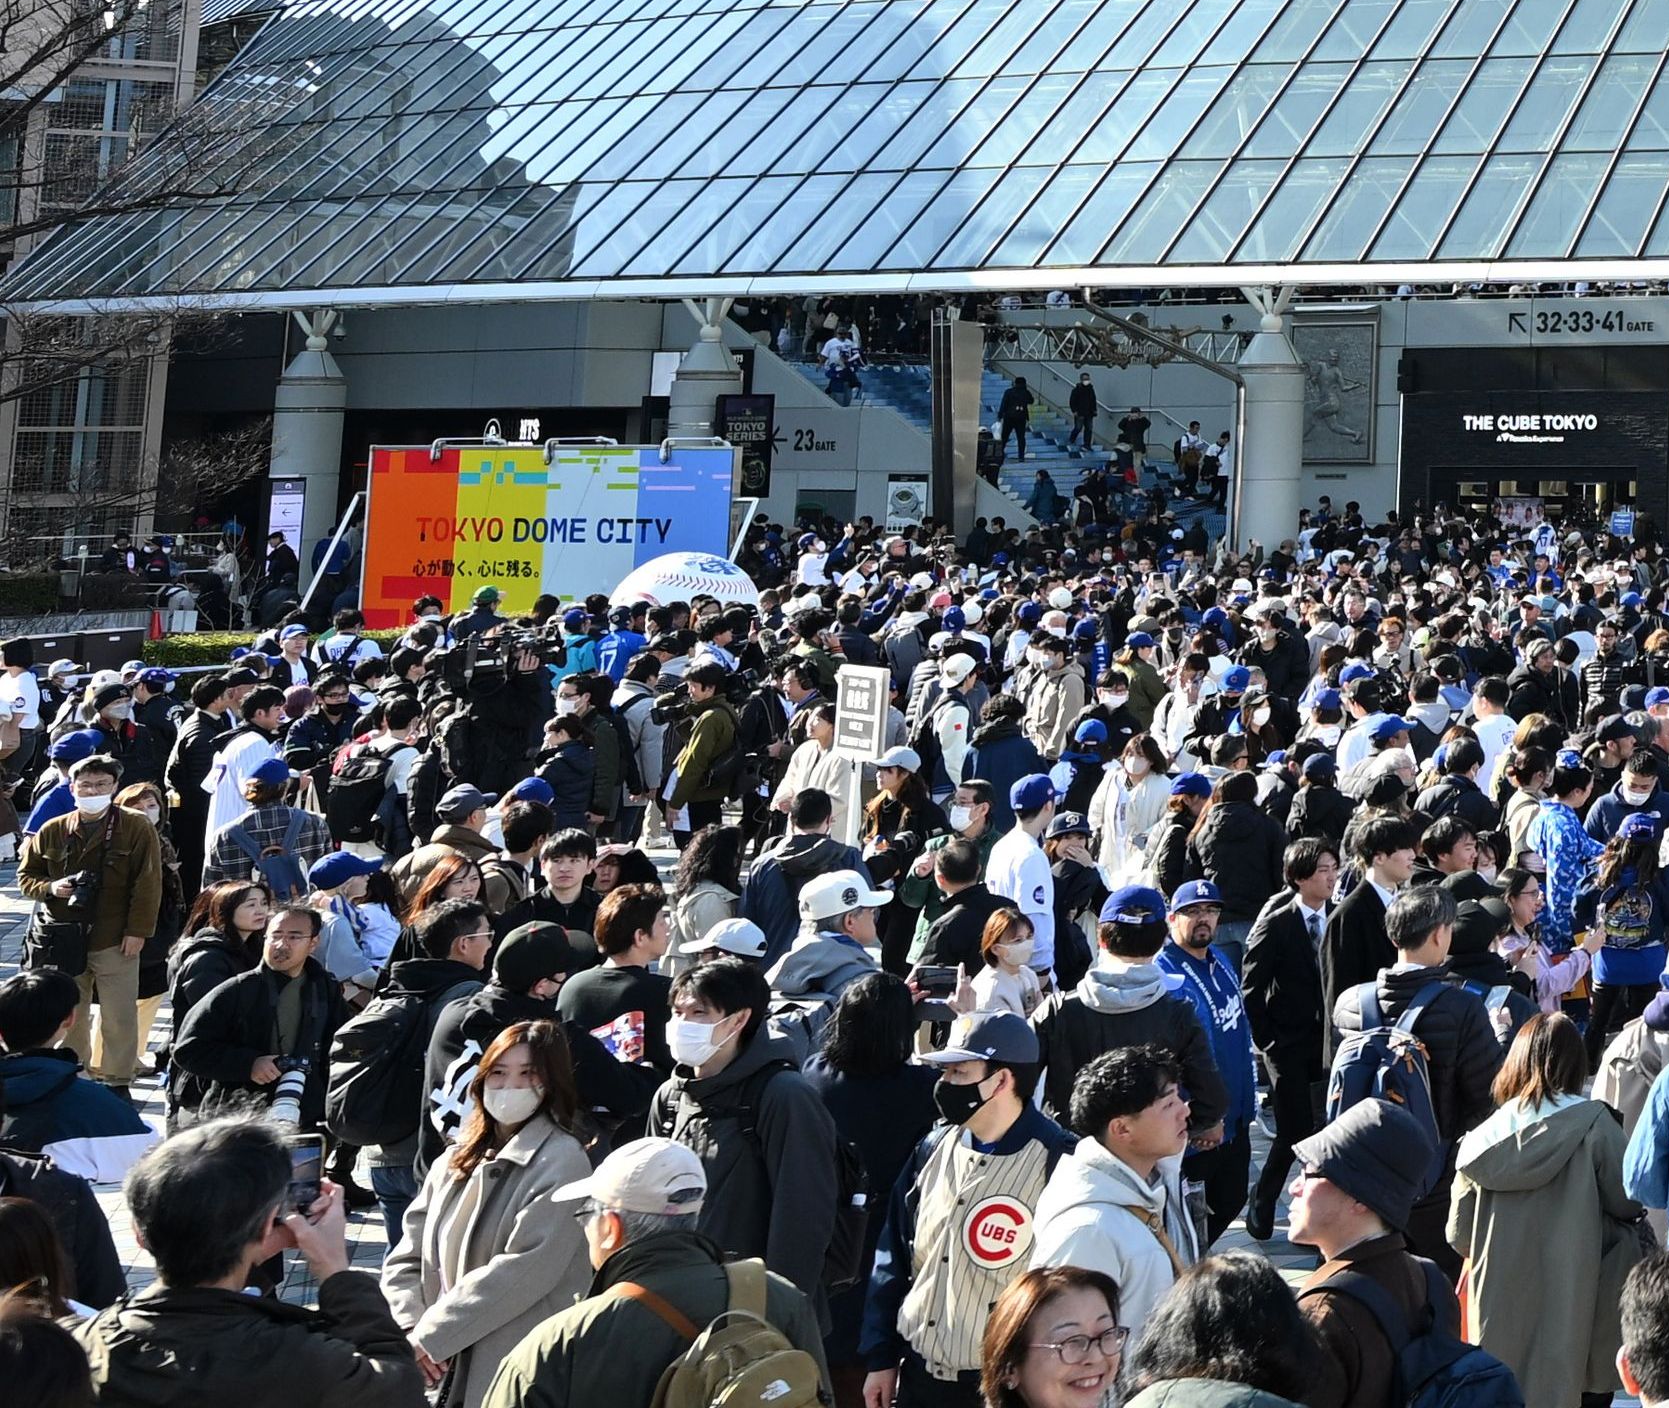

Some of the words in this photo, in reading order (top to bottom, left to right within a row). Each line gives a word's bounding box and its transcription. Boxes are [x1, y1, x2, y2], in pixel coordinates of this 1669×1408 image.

[1626, 321, 1655, 332] GATE
[727, 422, 766, 432] TOKYO
[1463, 415, 1494, 430] THE
[1497, 415, 1541, 430] CUBE
[1543, 414, 1597, 430] TOKYO
[726, 432, 767, 442] SERIES
[794, 429, 815, 452] 23
[815, 441, 836, 451] GATE
[416, 517, 504, 543] TOKYO
[512, 517, 587, 543] DOME
[596, 517, 673, 544] CITY
[412, 559, 541, 580] 心が動く、心に残る。
[600, 649, 618, 675] 17
